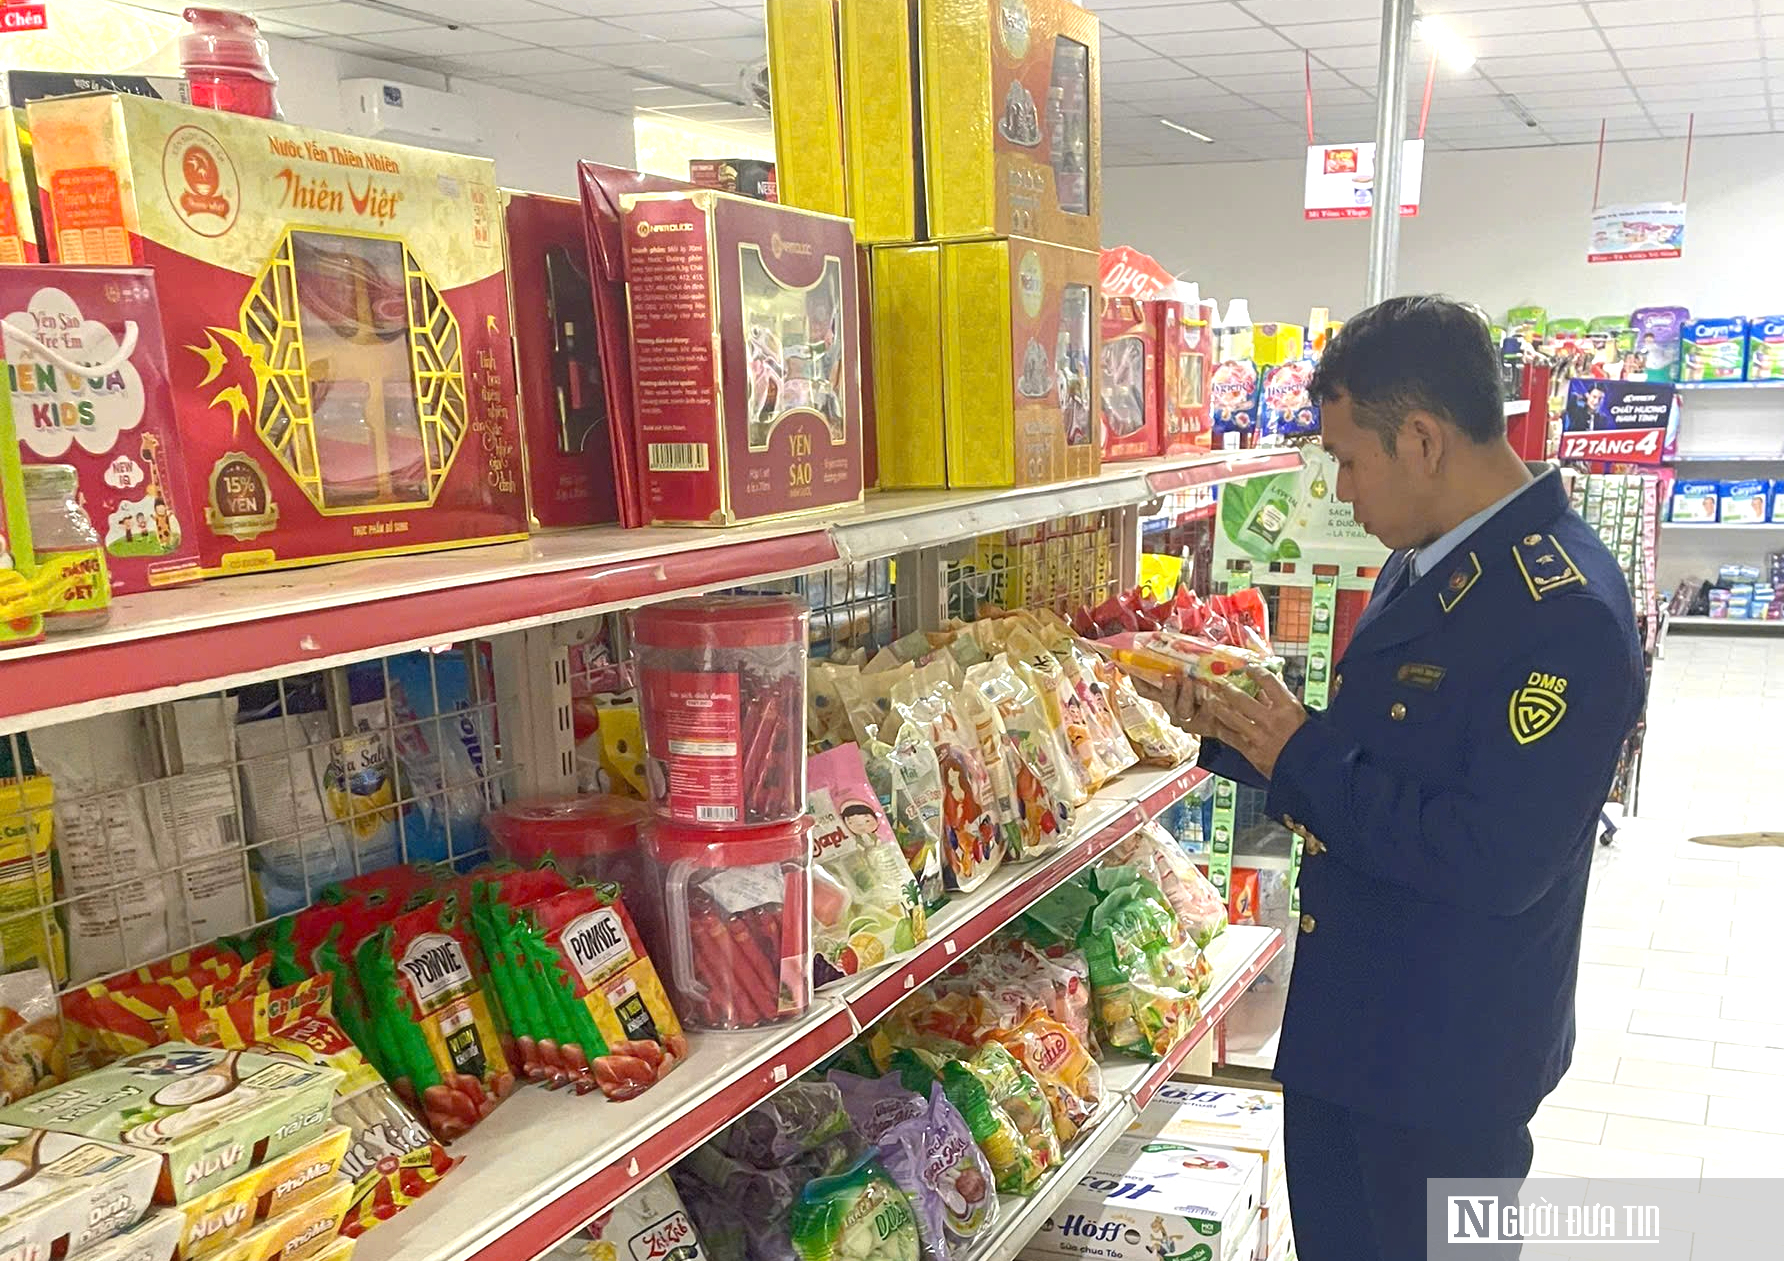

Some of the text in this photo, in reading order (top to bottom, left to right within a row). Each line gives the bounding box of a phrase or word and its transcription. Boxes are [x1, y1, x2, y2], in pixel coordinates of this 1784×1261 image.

[5, 12, 43, 26] Chén
[329, 147, 364, 169] Thiên
[365, 153, 400, 174] Nhiên
[275, 168, 399, 226] Thiên Việt
[32, 400, 96, 428] KIDS
[1565, 438, 1588, 457] 12
[1635, 430, 1660, 455] 4
[223, 475, 255, 494] 15%
[1528, 671, 1568, 694] DMS
[1057, 1214, 1126, 1242] Höff
